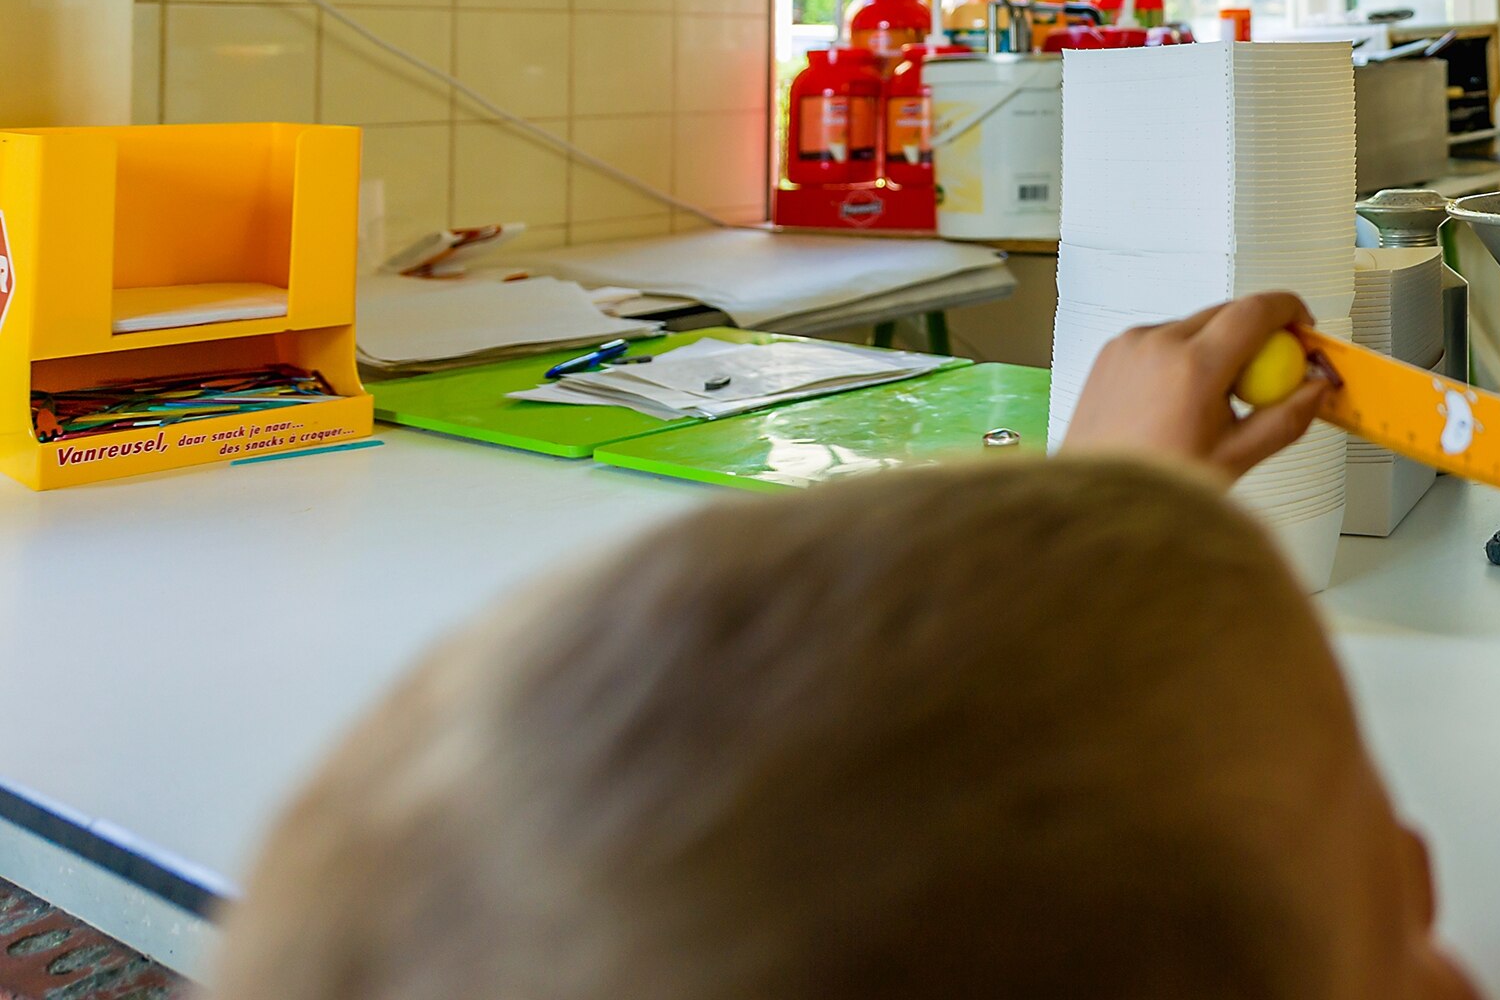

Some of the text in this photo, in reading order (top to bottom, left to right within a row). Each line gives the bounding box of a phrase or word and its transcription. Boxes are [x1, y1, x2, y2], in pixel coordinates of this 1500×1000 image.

[57, 421, 304, 466] Vanreusel, daar snack je naar...
[219, 427, 355, 456] des snacks à croquer...
